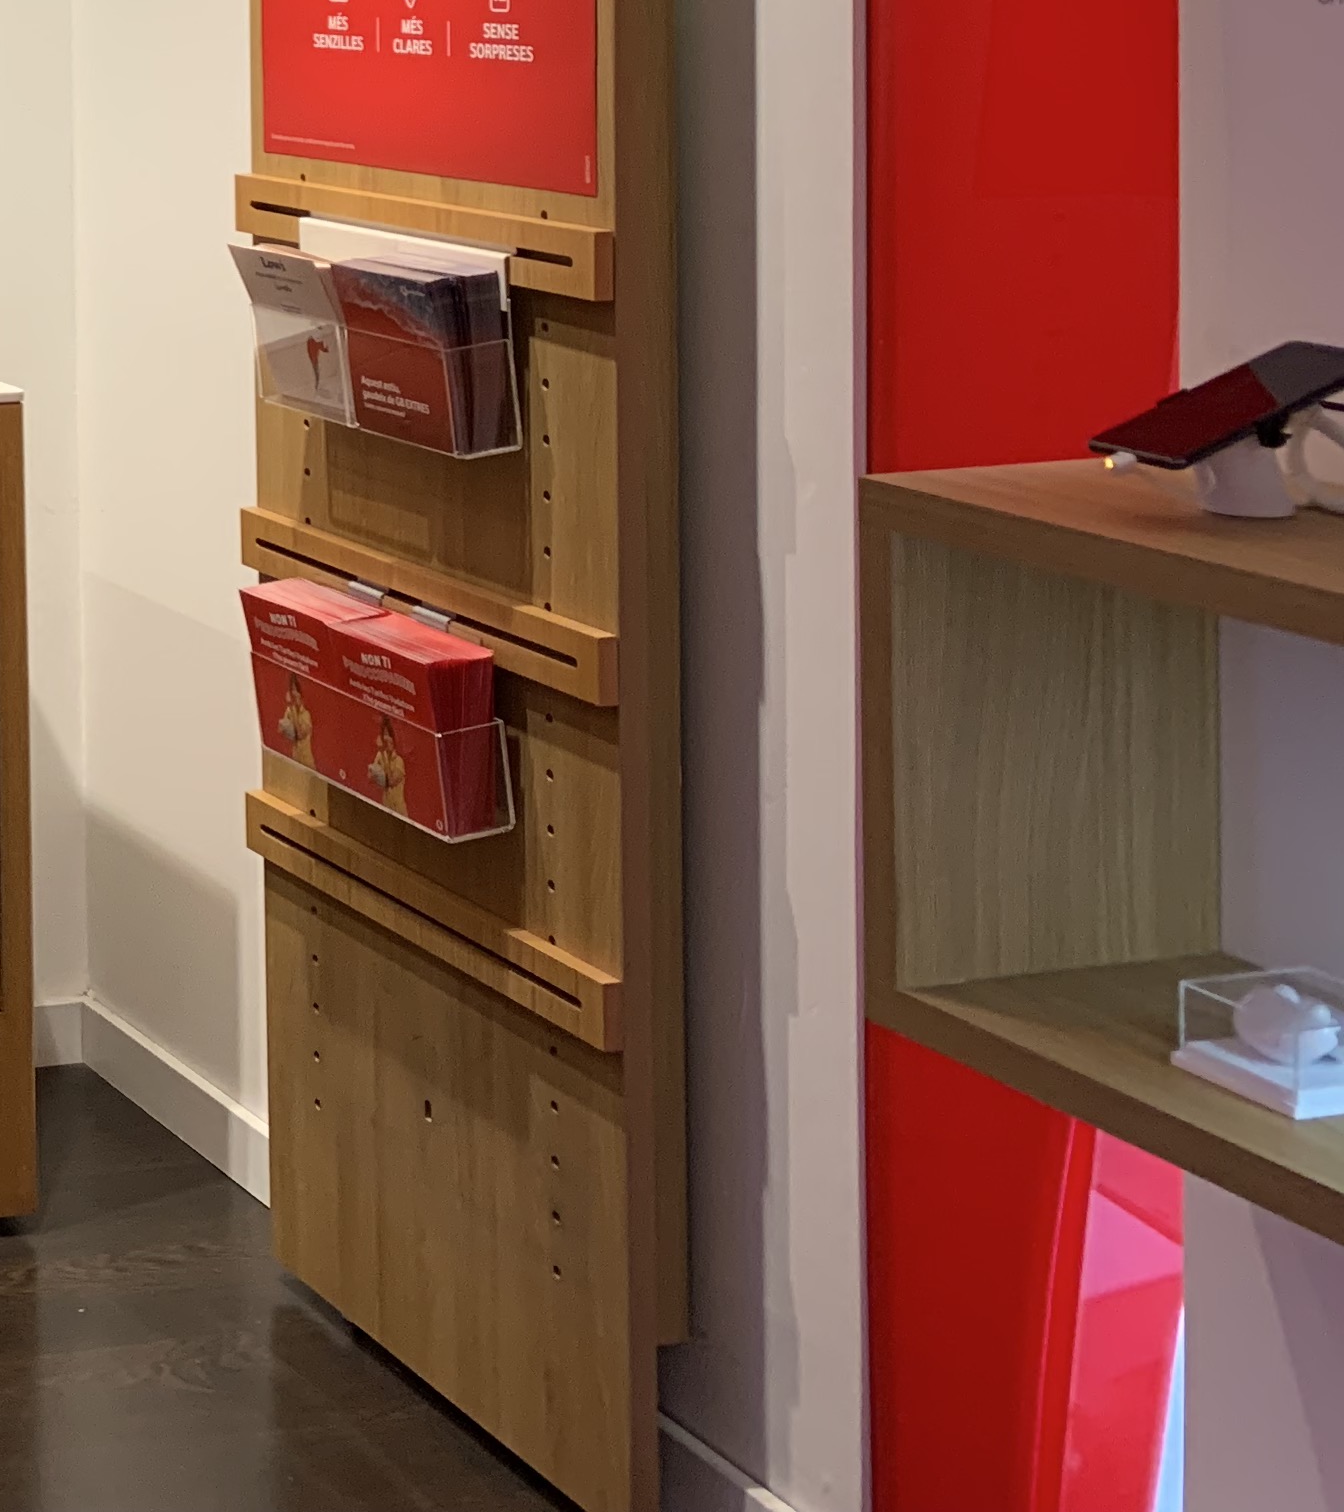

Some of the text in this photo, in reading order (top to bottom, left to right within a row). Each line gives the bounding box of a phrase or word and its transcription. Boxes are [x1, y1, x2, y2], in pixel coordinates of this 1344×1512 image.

[327, 13, 349, 31] MÉS
[401, 16, 423, 35] MÉS
[483, 22, 519, 40] SENSE
[313, 33, 364, 51] SENZILLES
[393, 38, 433, 56] CLARES
[469, 42, 534, 63] SORPRESES
